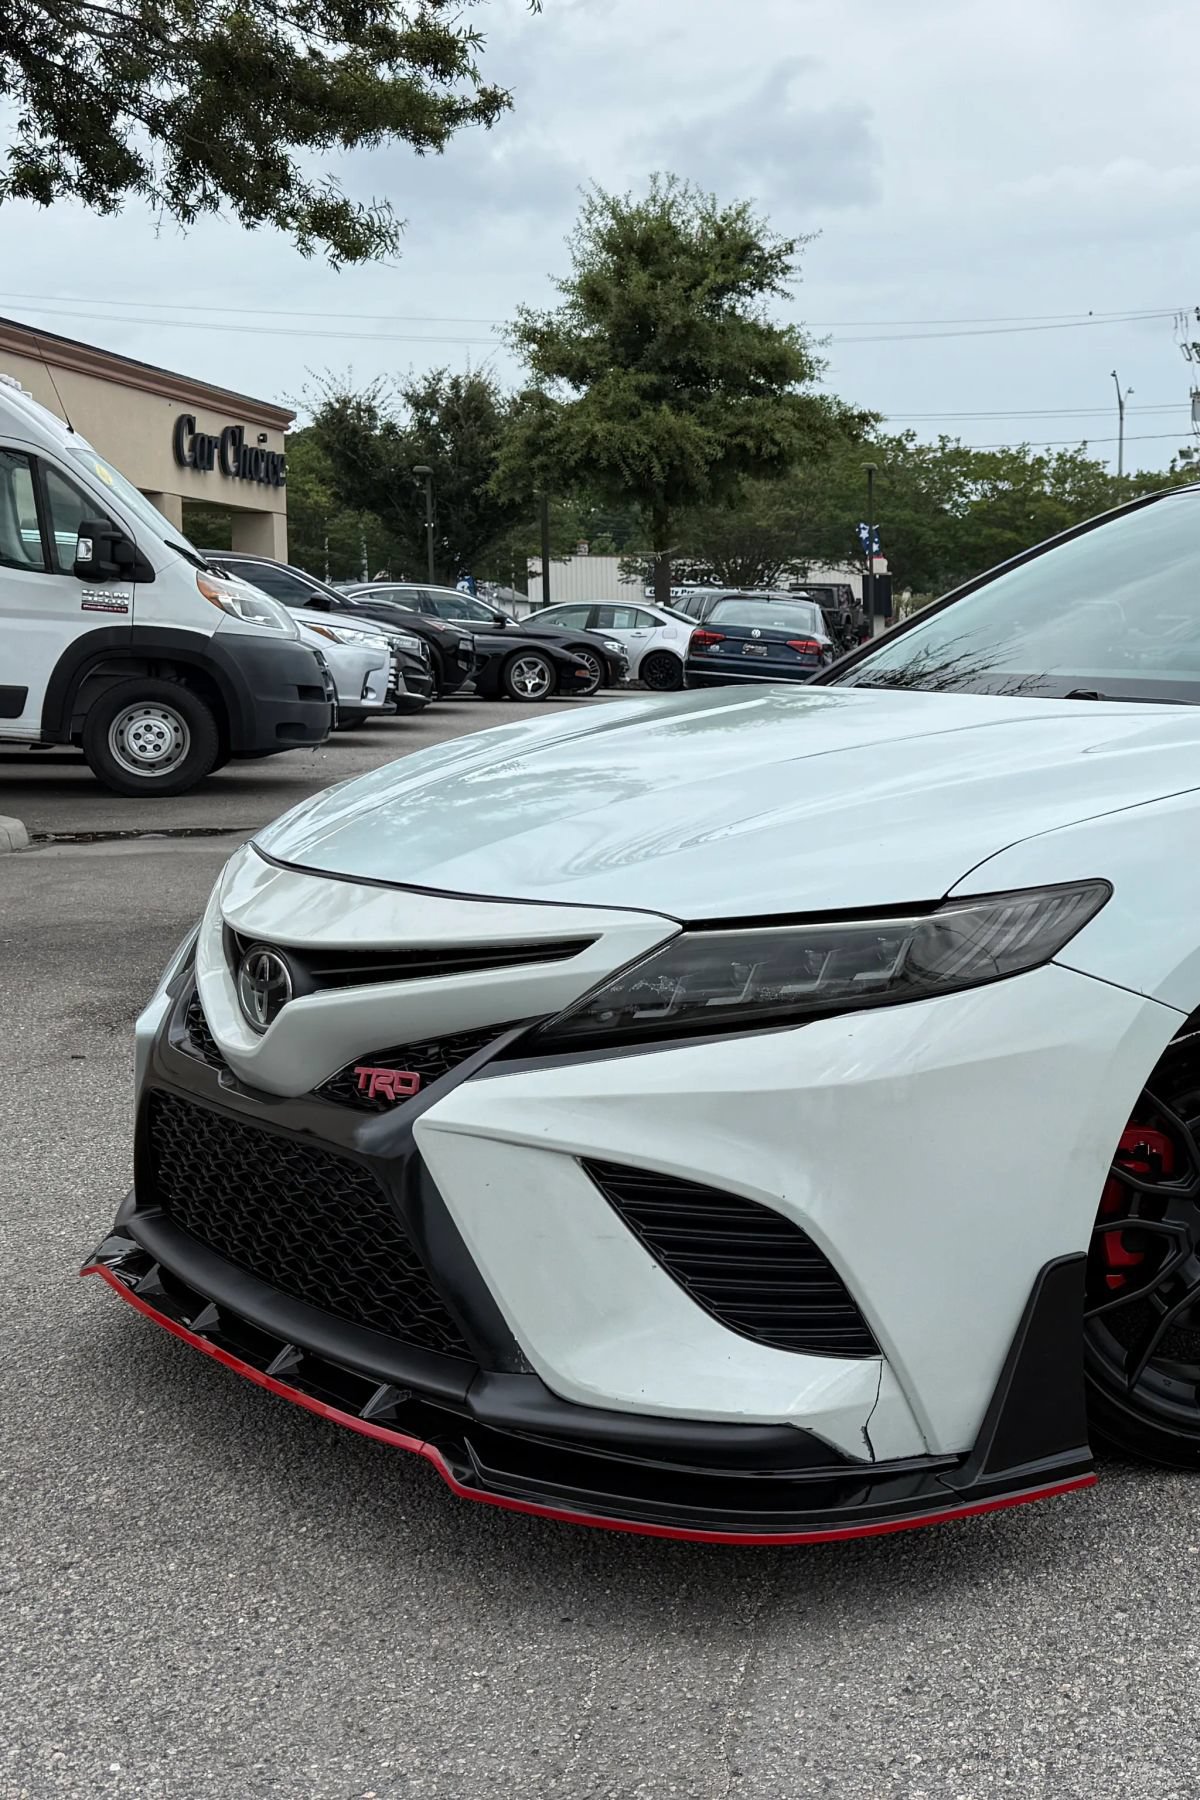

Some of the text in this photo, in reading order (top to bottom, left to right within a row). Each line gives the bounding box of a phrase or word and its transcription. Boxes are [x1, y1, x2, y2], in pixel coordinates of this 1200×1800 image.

[173, 414, 286, 487] Car Choice
[354, 1066, 420, 1100] TRD
